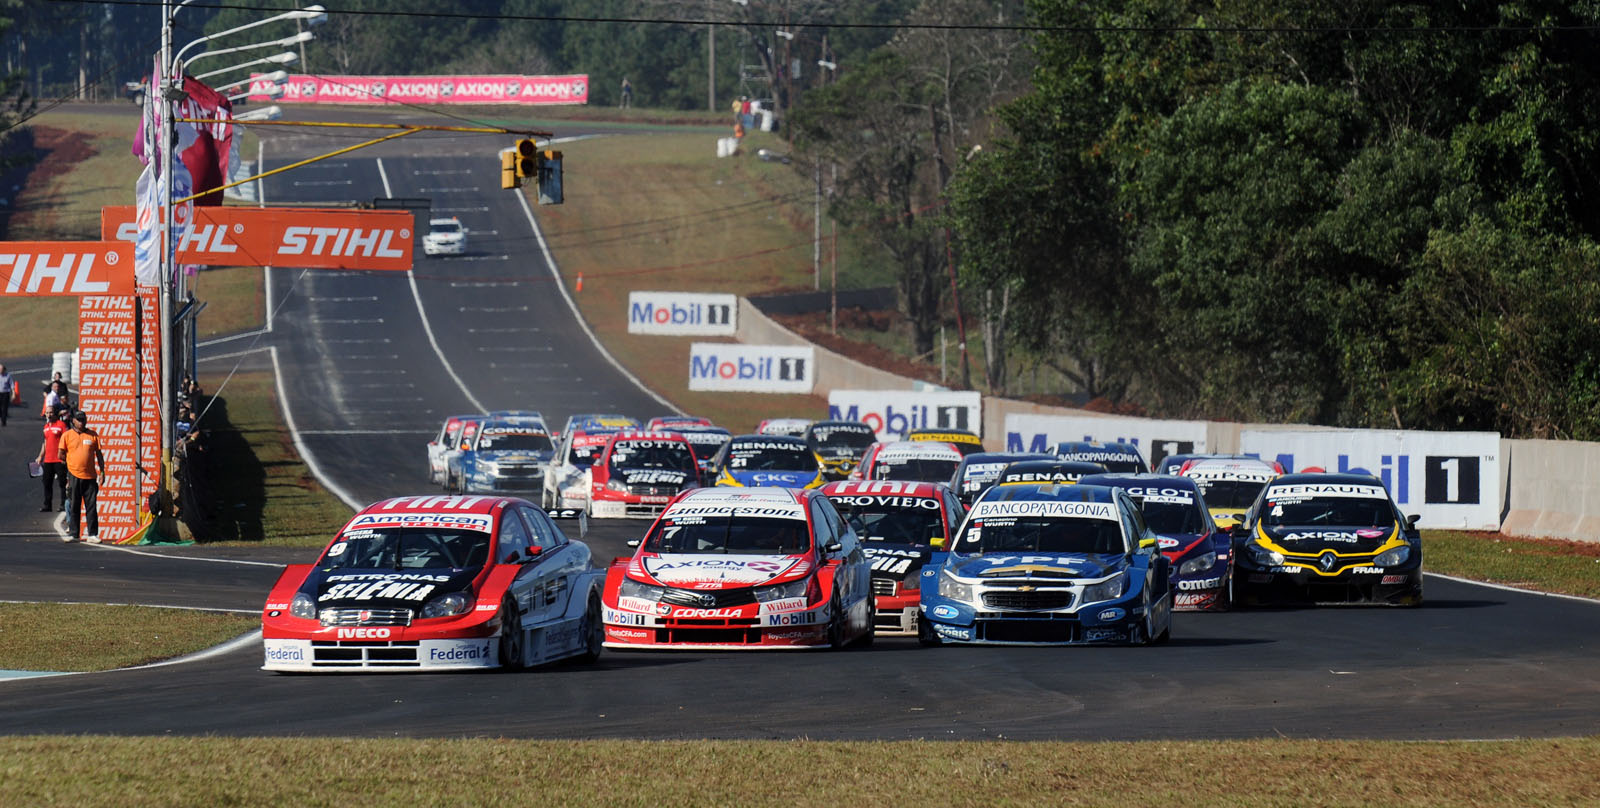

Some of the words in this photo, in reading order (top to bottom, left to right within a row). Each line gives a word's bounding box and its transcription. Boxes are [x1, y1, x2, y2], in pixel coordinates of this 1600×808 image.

[319, 83, 369, 96] AXION
[388, 83, 438, 96] AXION
[455, 83, 504, 96] AXION
[522, 83, 570, 96] AXION
[631, 302, 702, 325] Mobil
[692, 355, 771, 380] Mobil
[829, 404, 927, 434] Mobil
[615, 441, 687, 451] CROTTA
[732, 442, 807, 451] RENAULT
[731, 458, 747, 467] 21
[1058, 452, 1140, 463] BANCOPATAGONIA
[752, 474, 795, 483] CKC
[1006, 473, 1082, 482] RENAU
[1187, 472, 1267, 482] DuPon
[835, 480, 921, 494] FIAT
[1127, 487, 1193, 498] GEOT
[1273, 486, 1379, 495] RENAULT
[382, 495, 482, 510] FIAT
[981, 501, 1111, 516] BANCOPATAGONIA
[668, 506, 801, 517] BRIDGESTONE
[1270, 505, 1284, 517] 4
[355, 515, 488, 526] American
[664, 526, 682, 540] 7
[966, 527, 981, 543] 5
[1283, 531, 1358, 541] AXION
[328, 542, 348, 557] 9
[655, 560, 746, 570] AXION
[983, 556, 1086, 565] YPF
[1270, 566, 1302, 574] FRAM
[1353, 566, 1384, 574] FRAM
[326, 573, 451, 582] PETRONAS
[318, 580, 436, 602] SELENIA
[622, 599, 651, 612] Willard
[766, 599, 803, 612] Willard
[607, 611, 633, 624] Mobil
[673, 608, 743, 618] COROLLA
[769, 613, 806, 625] Mobil
[338, 629, 390, 638] IVECO
[267, 647, 304, 660] Federal
[430, 646, 480, 660] Federal
